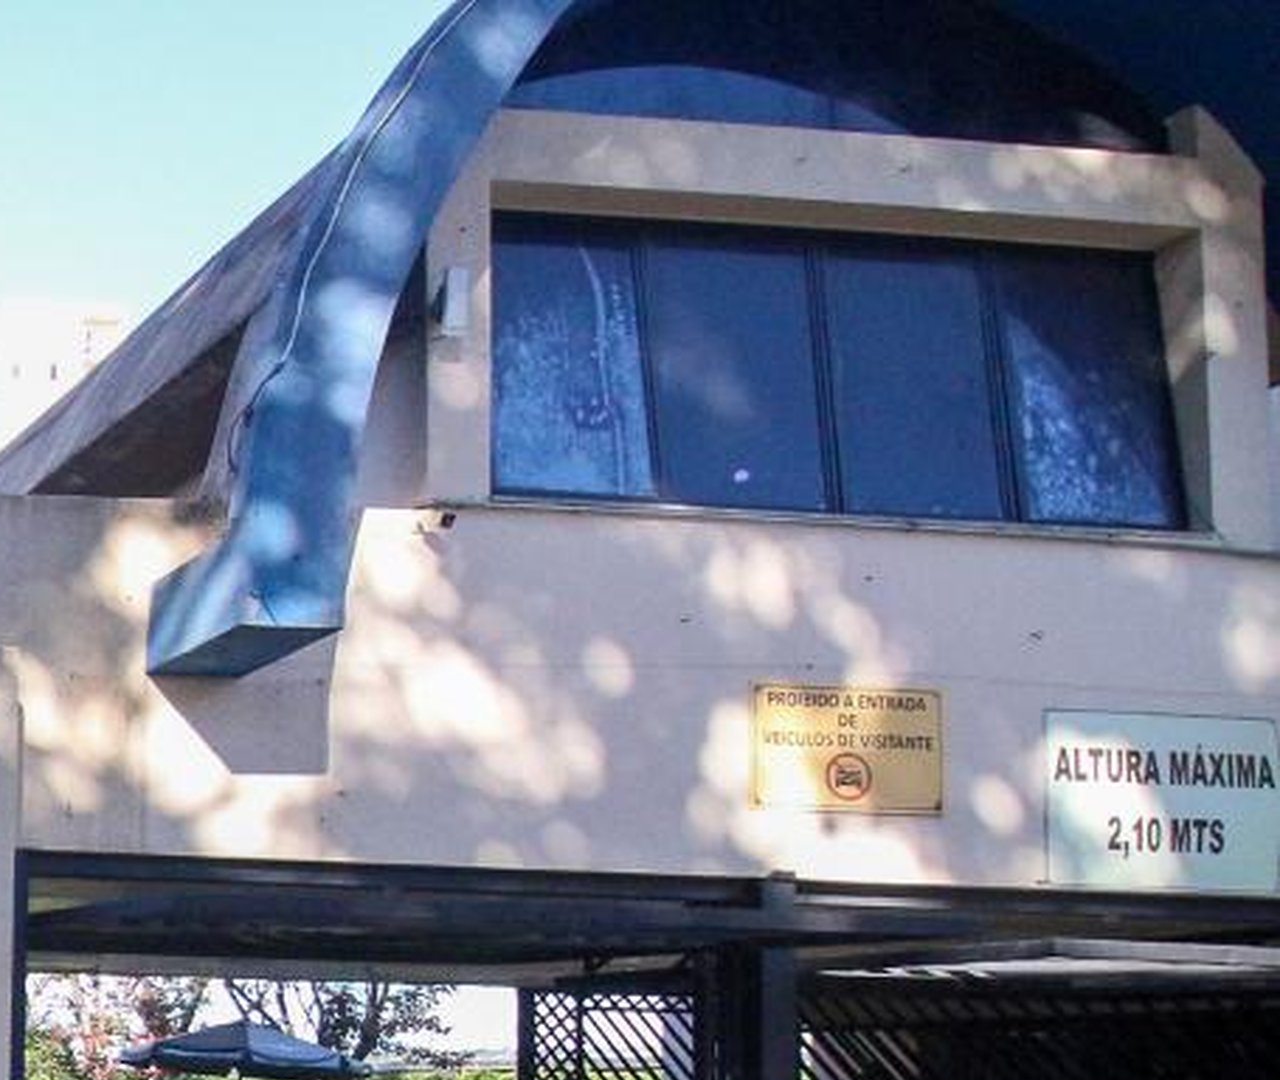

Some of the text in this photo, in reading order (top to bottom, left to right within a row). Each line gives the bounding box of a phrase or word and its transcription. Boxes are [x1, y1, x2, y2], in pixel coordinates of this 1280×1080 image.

[858, 694, 927, 711] ENTRADA
[838, 714, 857, 727] DE
[838, 733, 855, 747] DE
[1054, 743, 1275, 788] ALTURA MÁXIMA
[1107, 817, 1225, 859] 2,10 MTS
